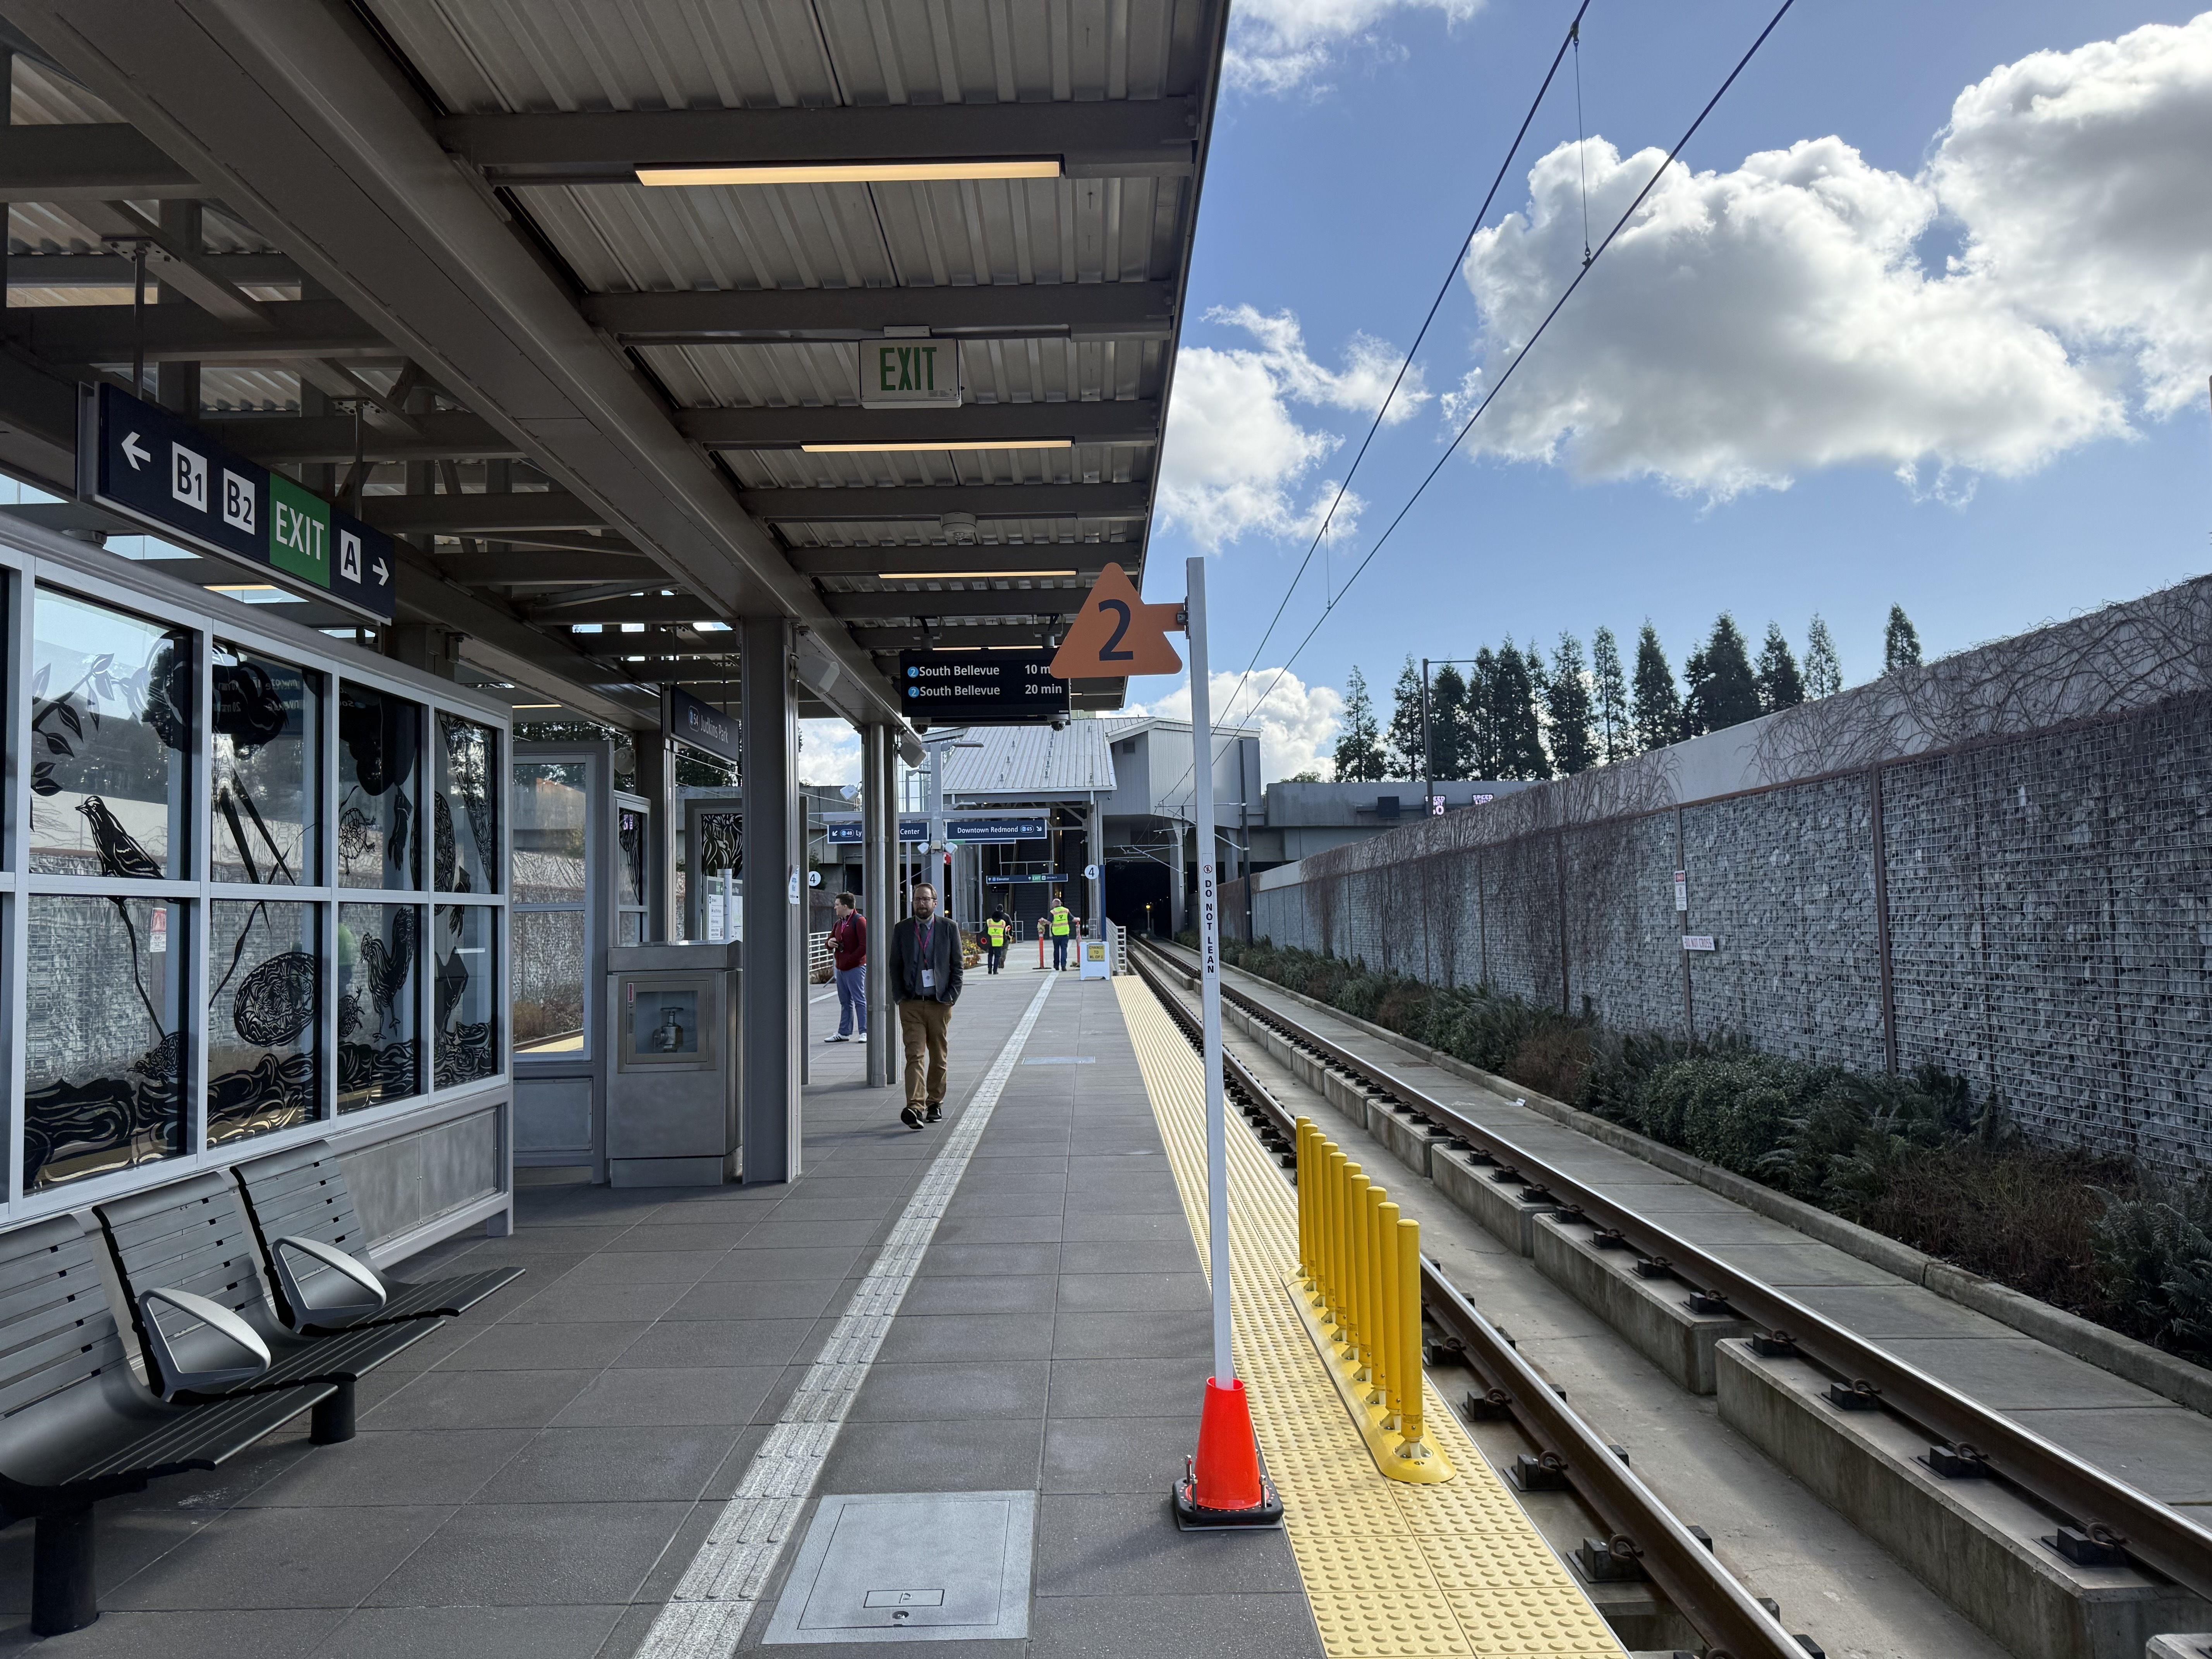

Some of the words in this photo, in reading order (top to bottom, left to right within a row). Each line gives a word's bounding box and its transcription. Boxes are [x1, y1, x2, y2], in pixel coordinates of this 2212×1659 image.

[880, 347, 937, 390] EXIT
[177, 452, 202, 502] B1
[227, 478, 252, 526] B2
[276, 501, 325, 560] EXIT
[344, 540, 358, 575] A
[1098, 599, 1134, 661] 2
[919, 665, 951, 676] South
[954, 665, 1000, 676] Bellevue
[1025, 664, 1037, 674] 10
[920, 685, 951, 696] South
[955, 685, 1000, 696] Bellevue
[1025, 684, 1038, 694] 20
[1041, 684, 1062, 694] min
[701, 715, 718, 738] Judkins
[718, 724, 728, 744] Park
[810, 874, 816, 883] 4
[1089, 867, 1095, 877] 4
[1205, 880, 1212, 897] DO
[898, 1592, 912, 1604] P
